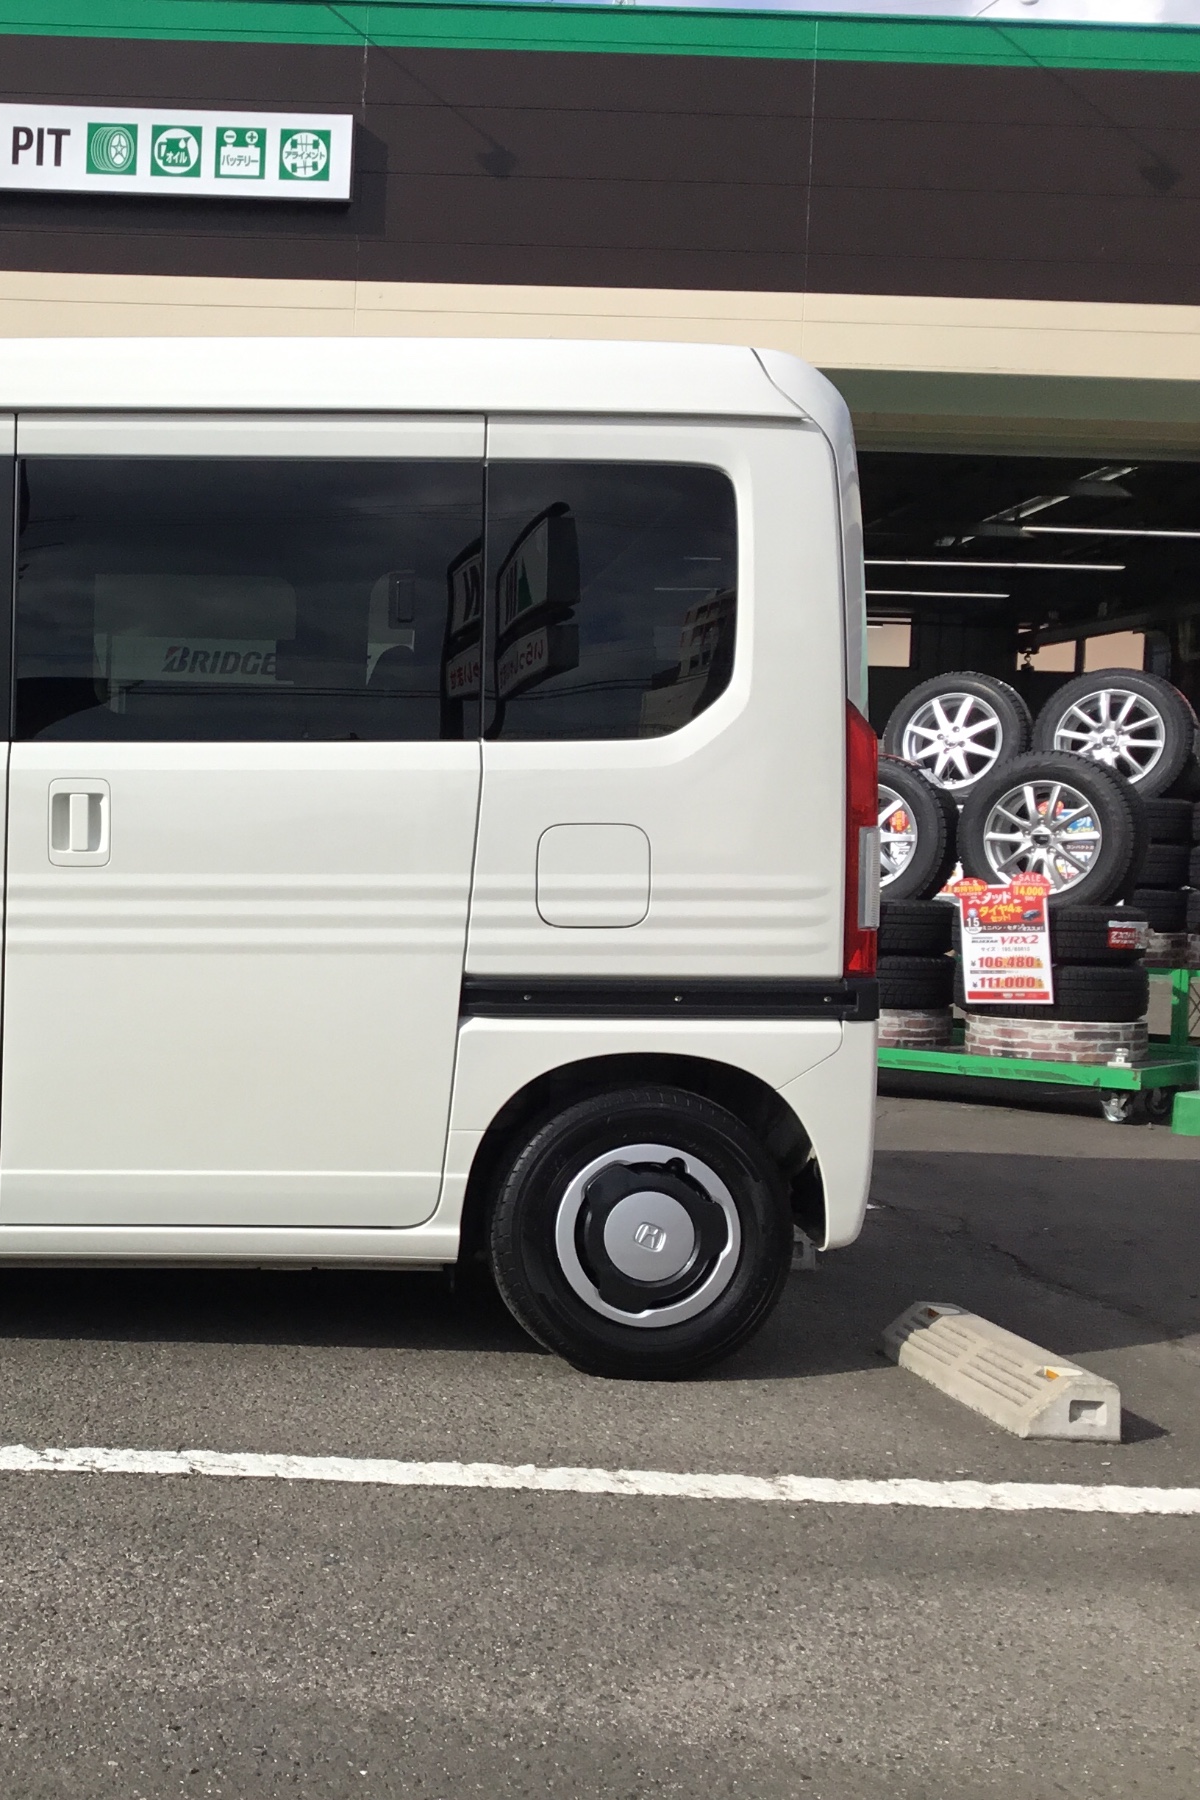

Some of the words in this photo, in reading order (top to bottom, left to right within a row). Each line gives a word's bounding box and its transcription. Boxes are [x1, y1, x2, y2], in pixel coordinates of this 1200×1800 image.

[12, 126, 71, 167] PIT
[166, 151, 188, 164] オイル
[221, 154, 259, 167] バッテリー
[284, 151, 325, 160] アライメント
[1018, 874, 1041, 883] SALE
[966, 917, 980, 927] 15
[1000, 935, 1039, 946] VRX2
